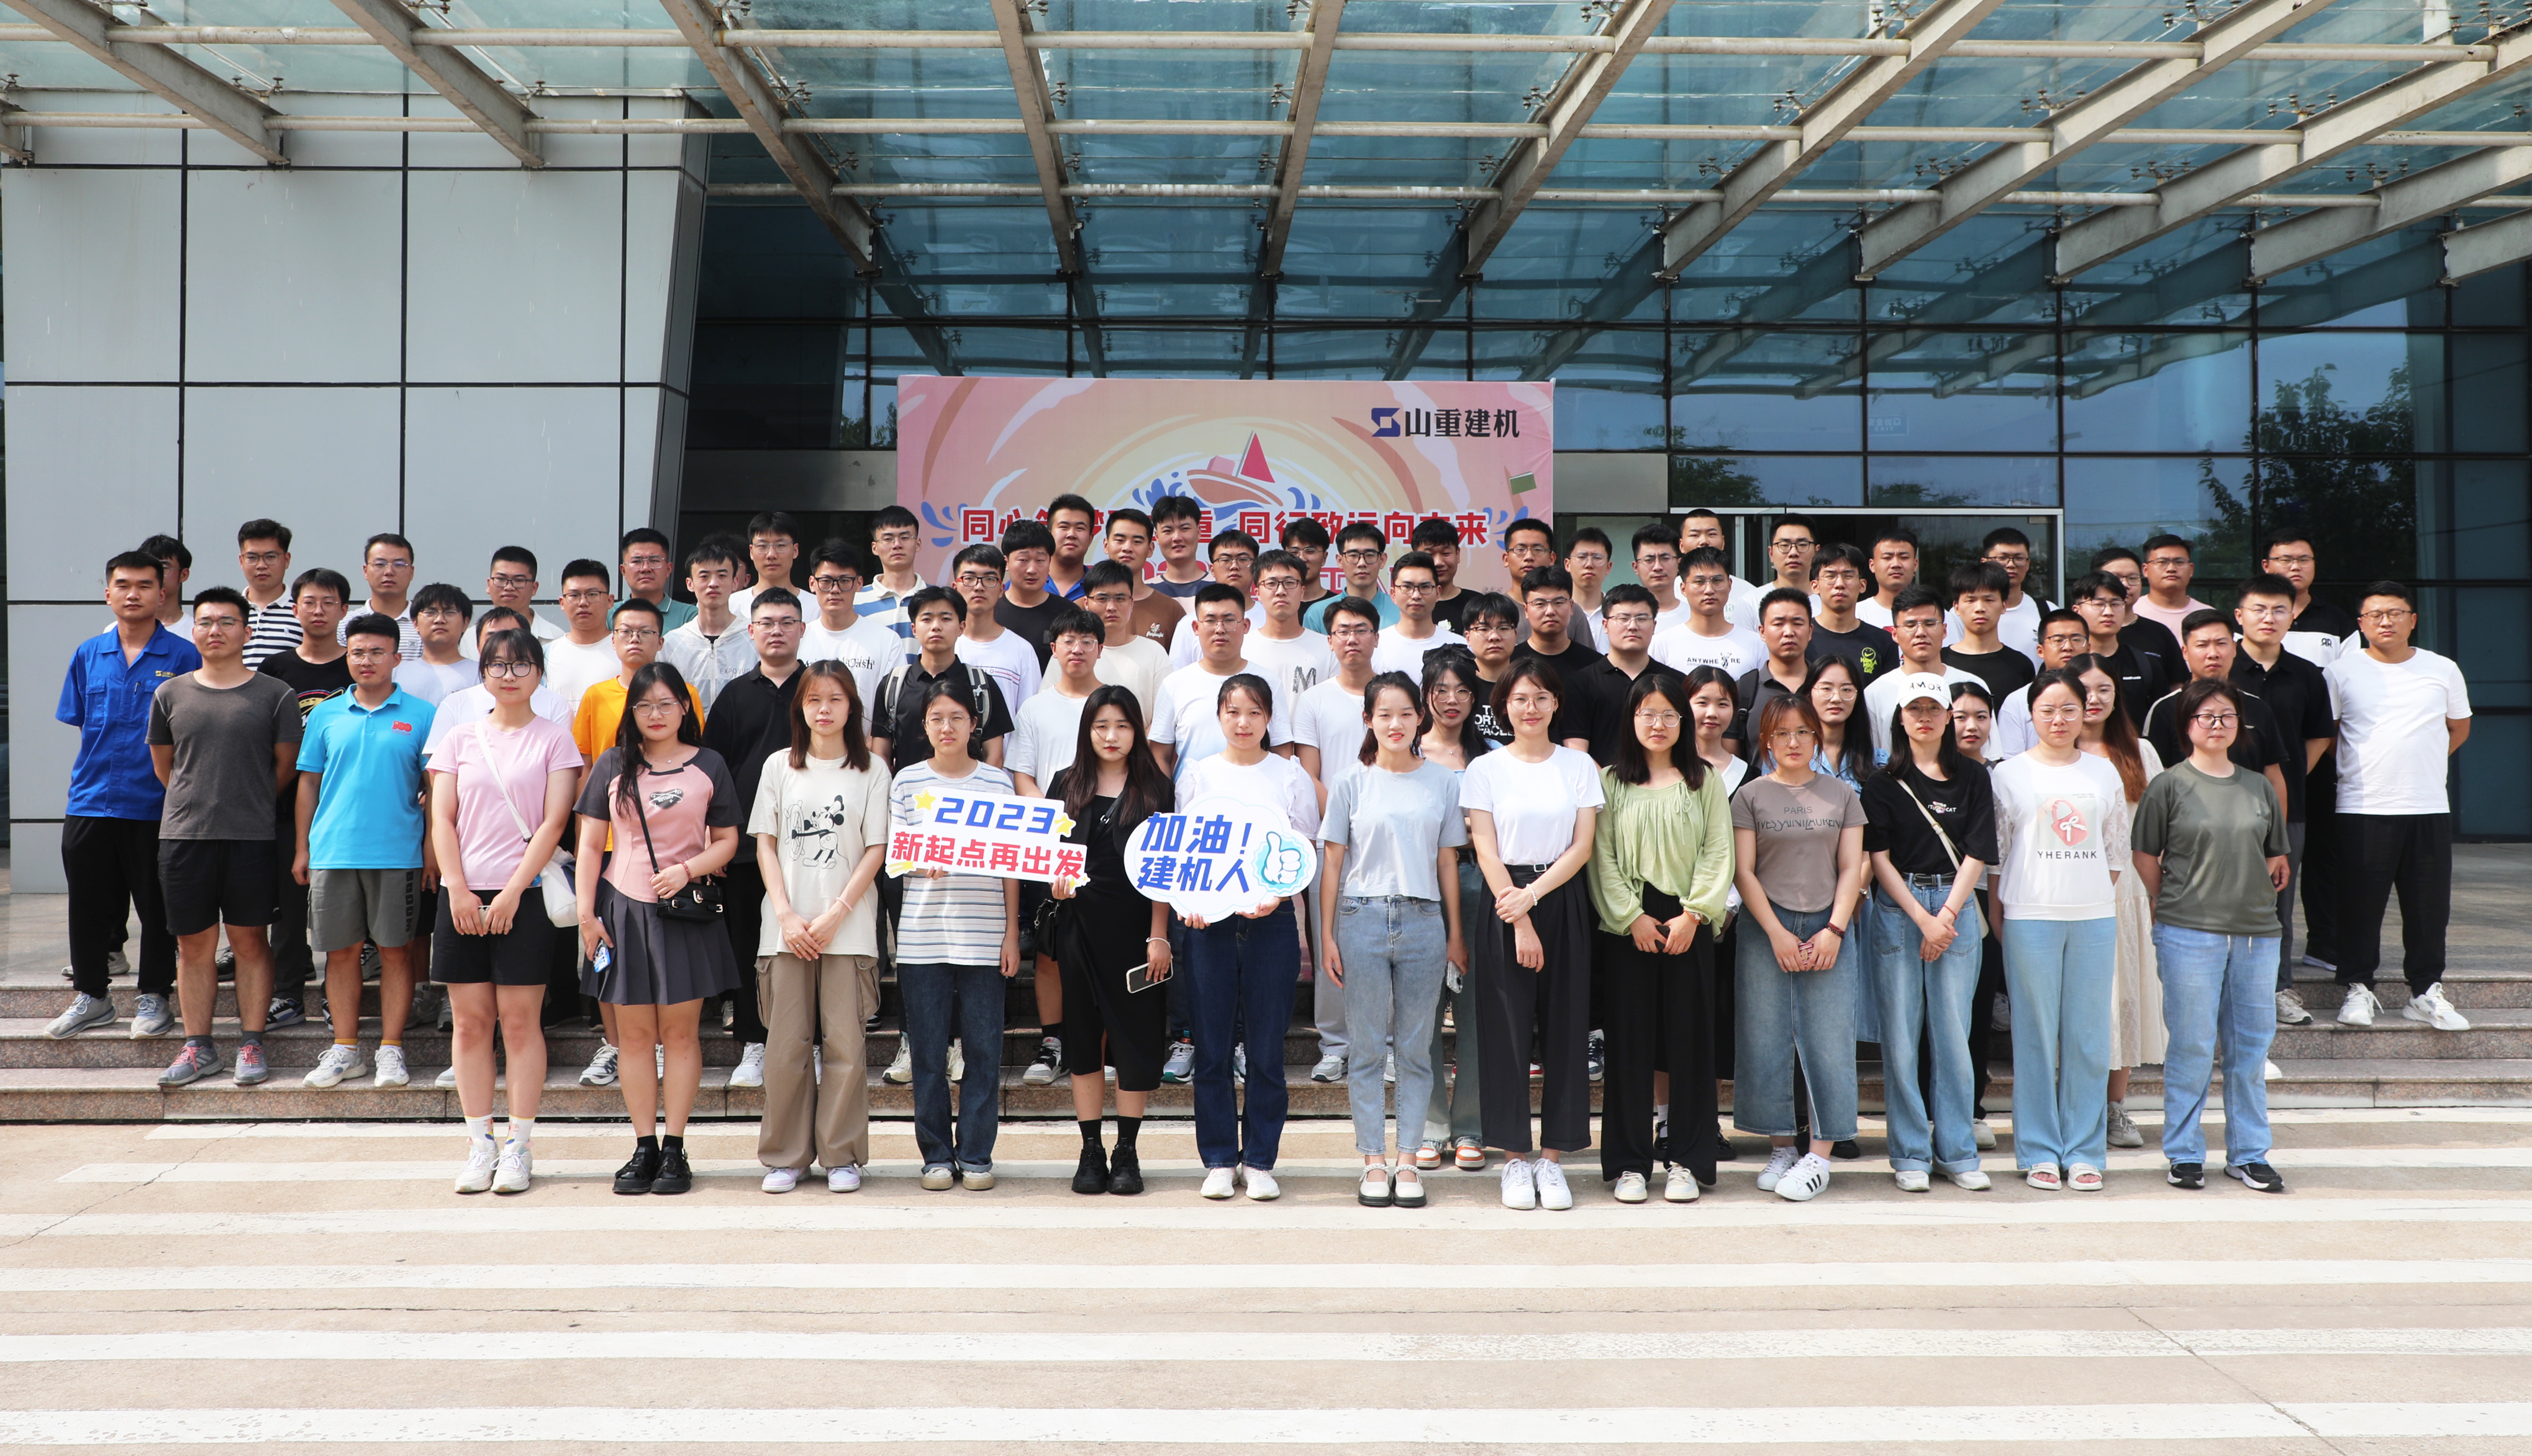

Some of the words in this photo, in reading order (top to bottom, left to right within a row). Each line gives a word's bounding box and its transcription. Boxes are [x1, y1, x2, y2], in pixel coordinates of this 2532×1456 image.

[1405, 408, 1520, 438] 山重建机
[1908, 682, 1941, 692] AMOR
[935, 797, 1055, 834] 2023
[891, 831, 1084, 879] 新起点再出发
[2037, 851, 2097, 859] YHERANK
[1137, 856, 1250, 893] 建机人
